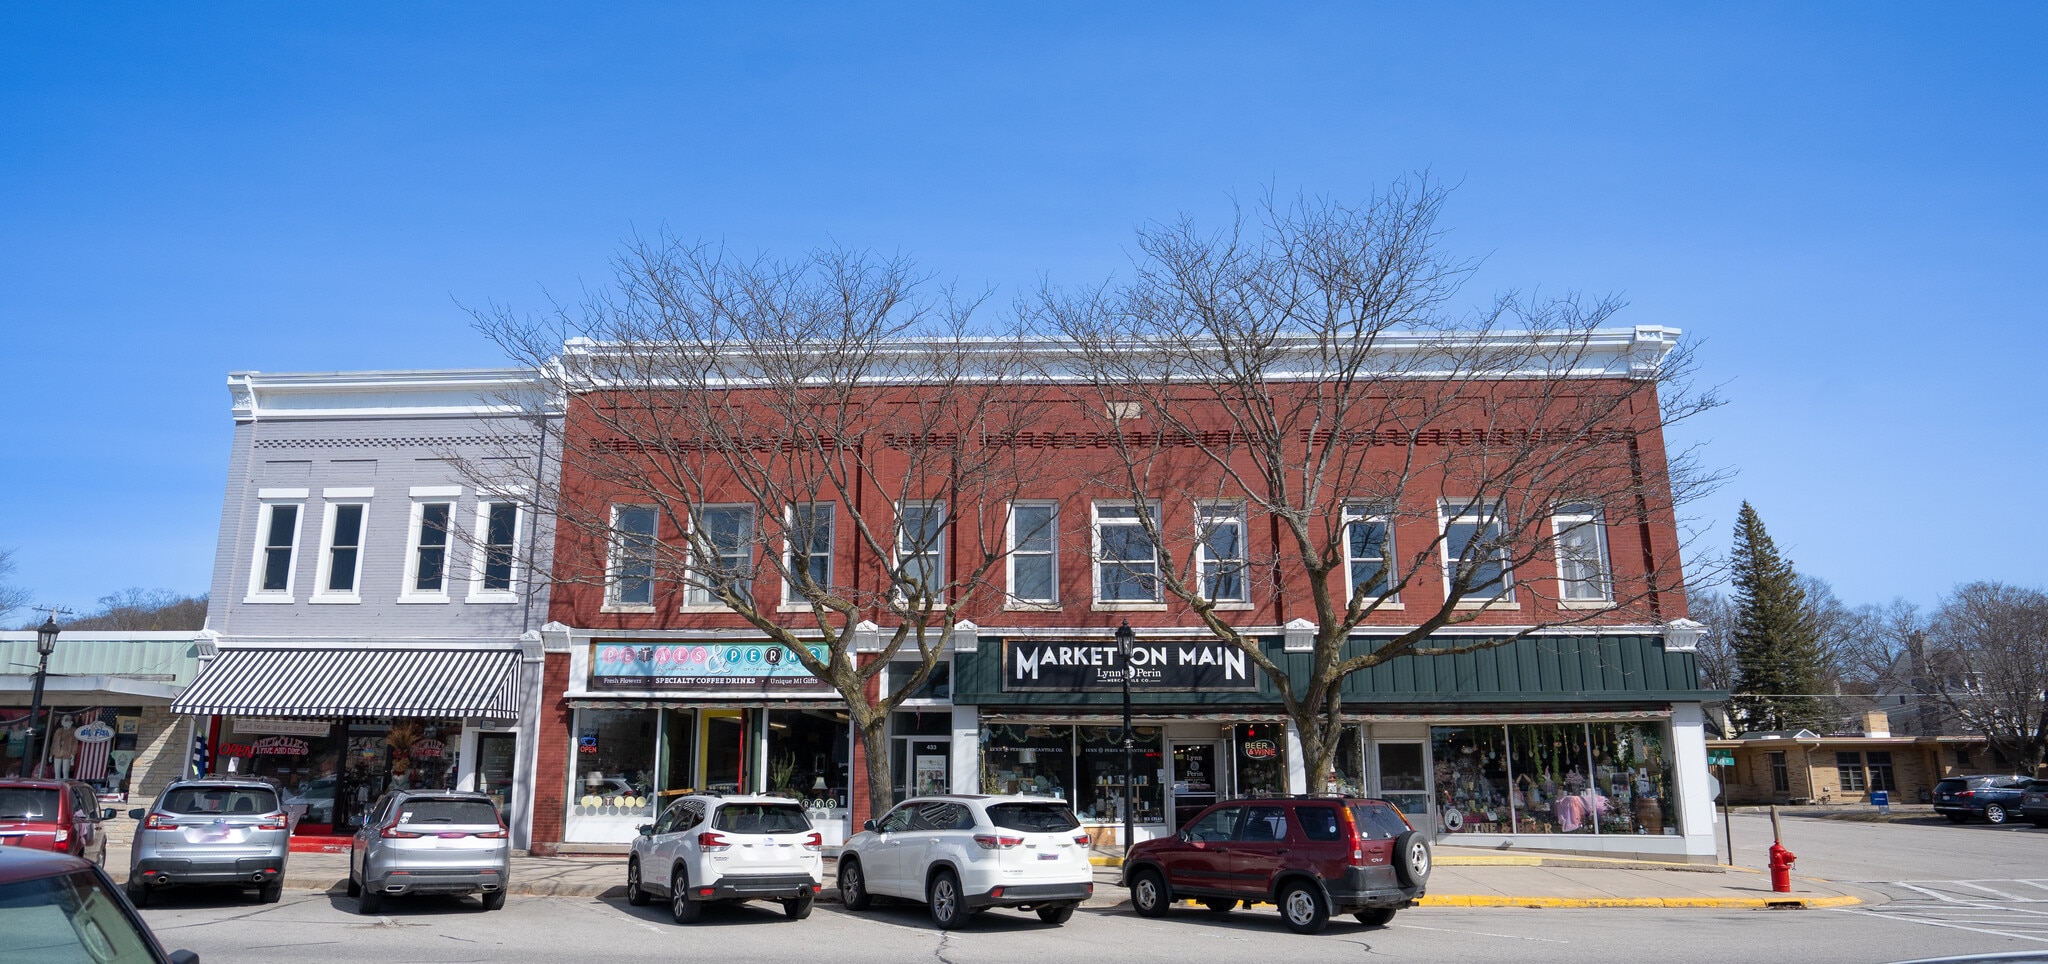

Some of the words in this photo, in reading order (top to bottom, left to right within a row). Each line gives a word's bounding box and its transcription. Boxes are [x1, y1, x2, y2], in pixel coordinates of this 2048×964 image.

[604, 648, 706, 663] PETALS
[704, 644, 731, 675] &
[1016, 646, 1117, 680] MARKET
[1130, 646, 1167, 666] ON
[1178, 646, 1246, 680] MAIN
[1097, 668, 1121, 679] Lynn
[1136, 668, 1162, 677] Perin
[770, 678, 792, 686] Unique
[218, 742, 256, 758] OPEN
[1186, 754, 1203, 762] Lynn
[1464, 822, 1498, 833] WINE
